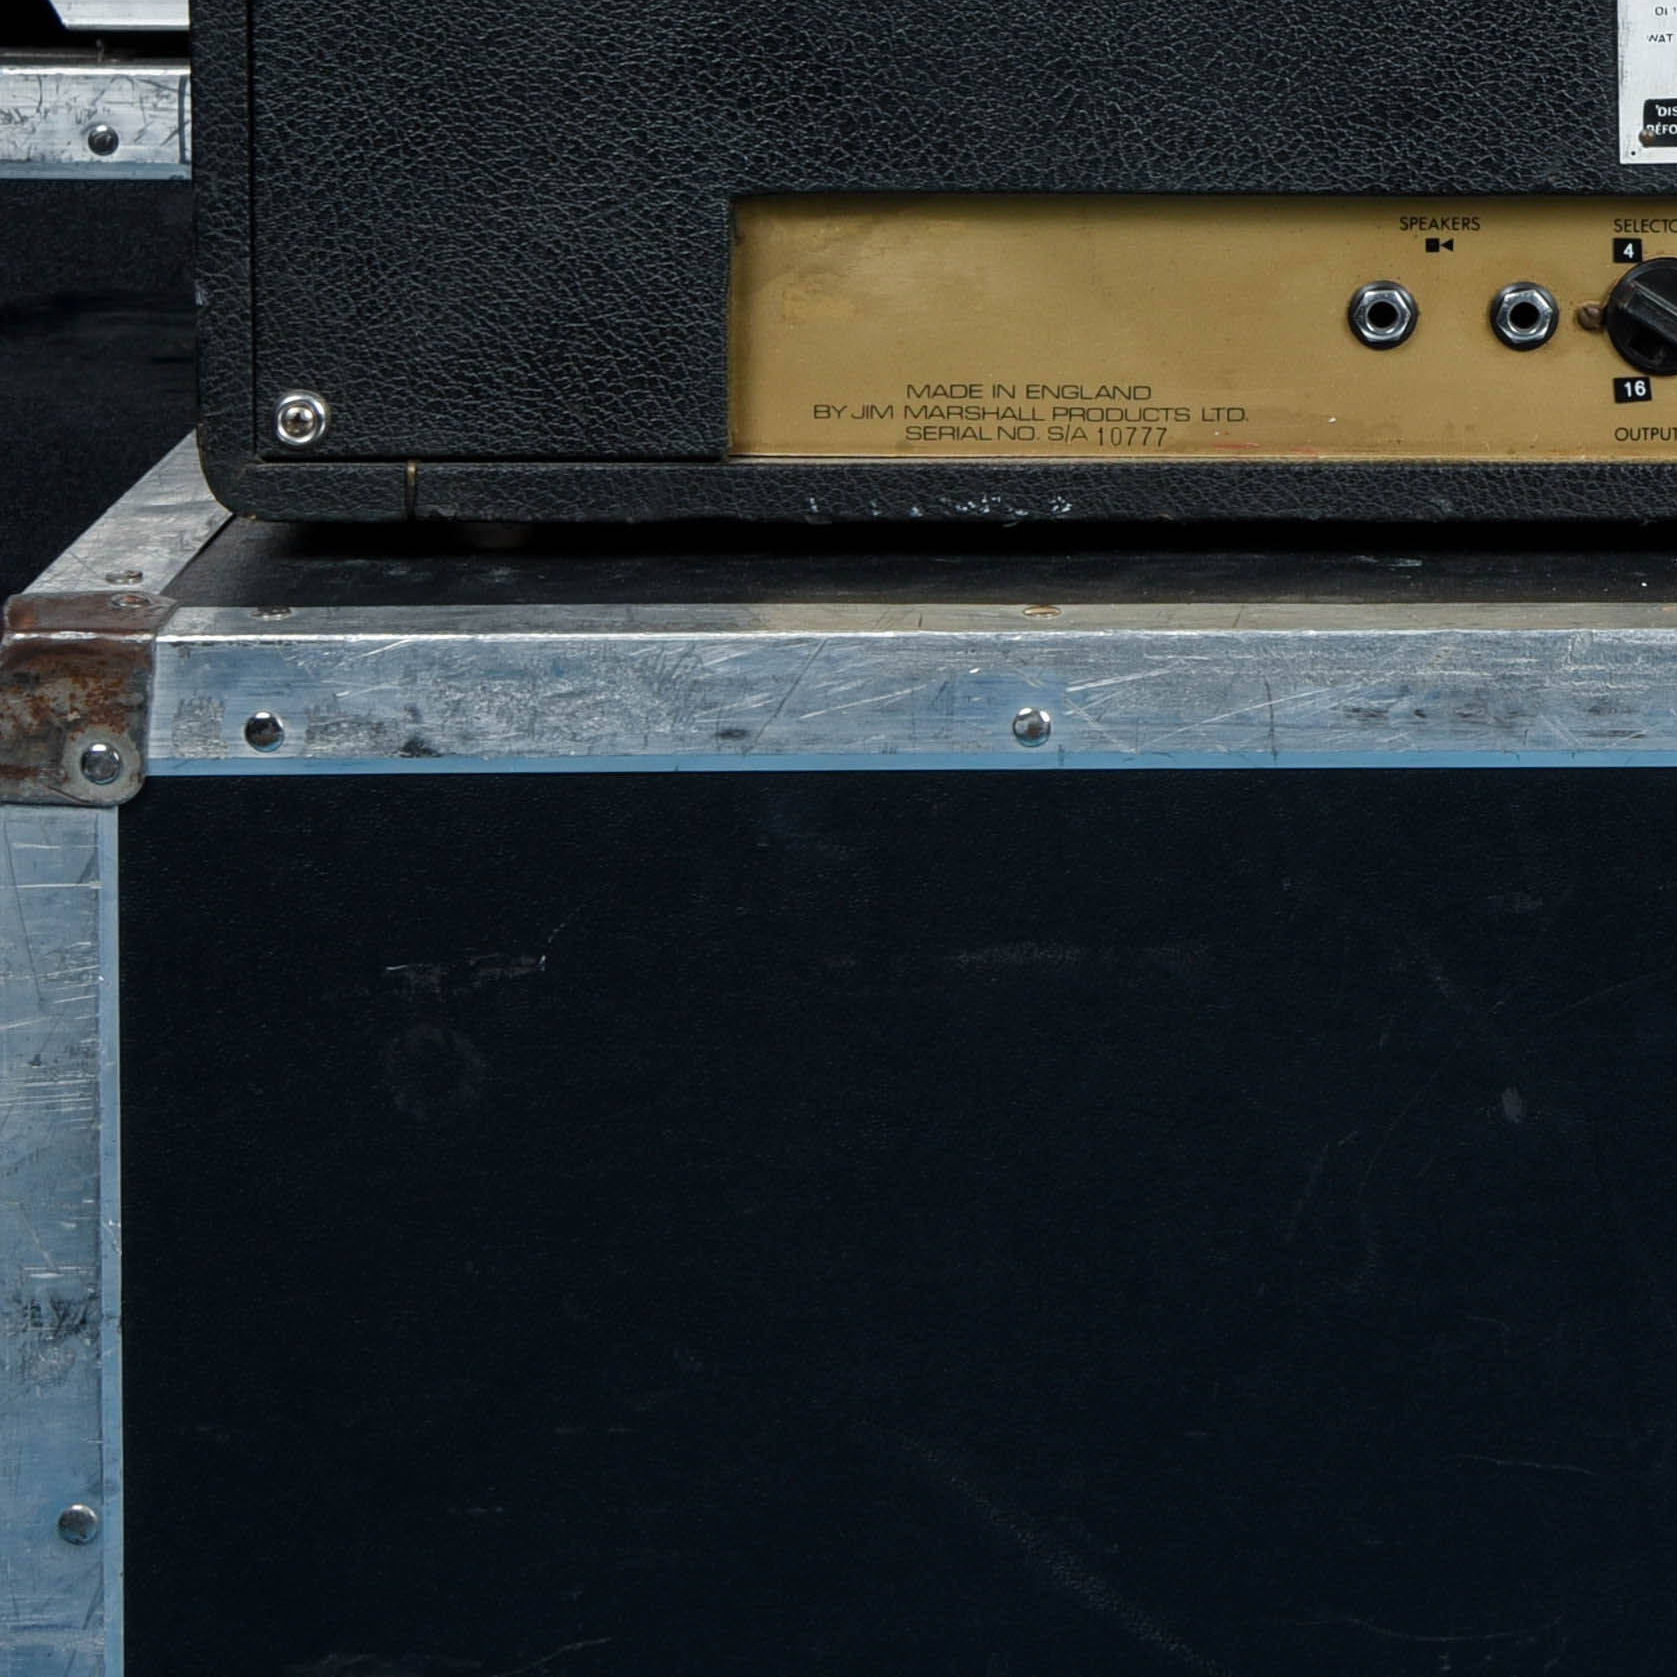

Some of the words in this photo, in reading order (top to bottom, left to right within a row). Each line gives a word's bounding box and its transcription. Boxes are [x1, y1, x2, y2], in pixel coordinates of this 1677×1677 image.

[1400, 216, 1480, 232] SPEAKERS
[1623, 243, 1634, 259] 4
[906, 384, 983, 400] MADE
[992, 384, 1016, 399] IN
[1026, 384, 1152, 400] ENGLAND
[1623, 380, 1647, 397] 16
[813, 404, 846, 420] BY
[851, 404, 894, 420] JIM
[903, 405, 1045, 421] MARSHALL
[1052, 406, 1190, 422] PRODUCTS
[1201, 406, 1250, 423] LTD.
[905, 425, 992, 441] SERIAL
[998, 425, 1040, 441] NO.
[1047, 425, 1088, 444] S/A
[1097, 426, 1168, 448] 10777
